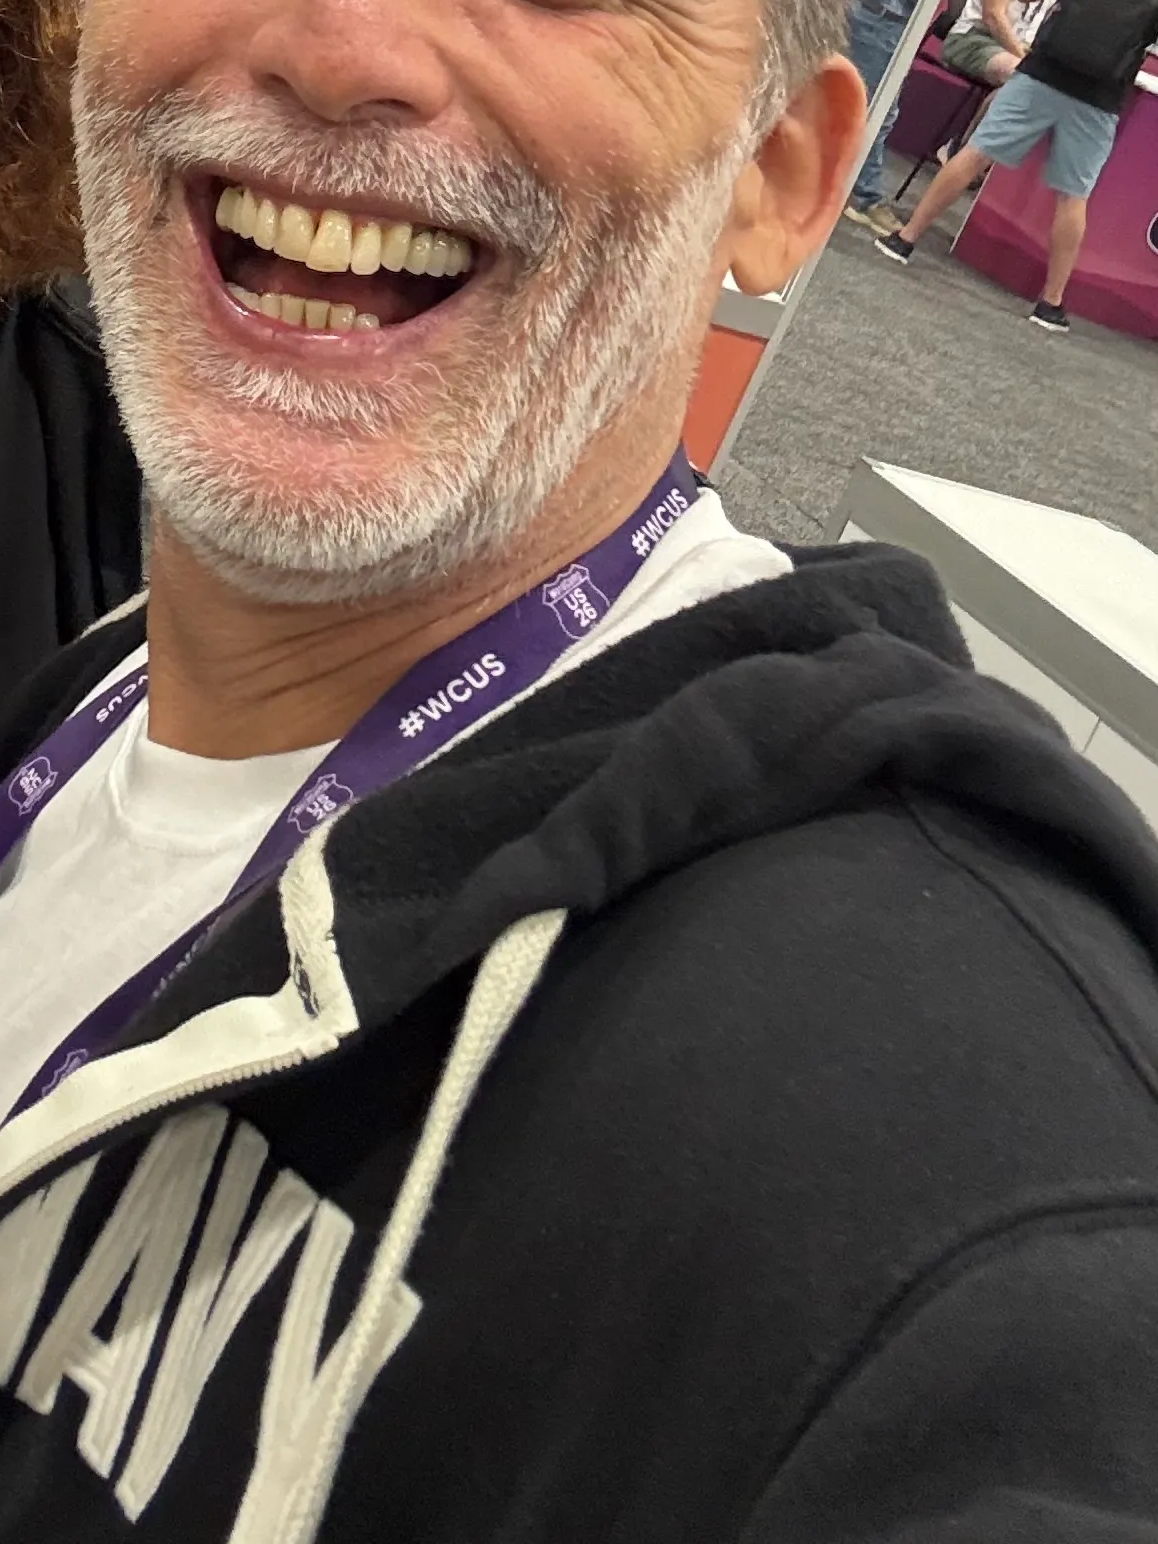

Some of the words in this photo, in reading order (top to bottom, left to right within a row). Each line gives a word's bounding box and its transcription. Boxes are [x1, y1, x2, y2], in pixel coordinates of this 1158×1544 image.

[631, 487, 689, 557] #WCUS
[563, 588, 587, 611] US
[573, 601, 598, 627] 26
[95, 675, 148, 723] CUS
[398, 653, 506, 738] #WCUS
